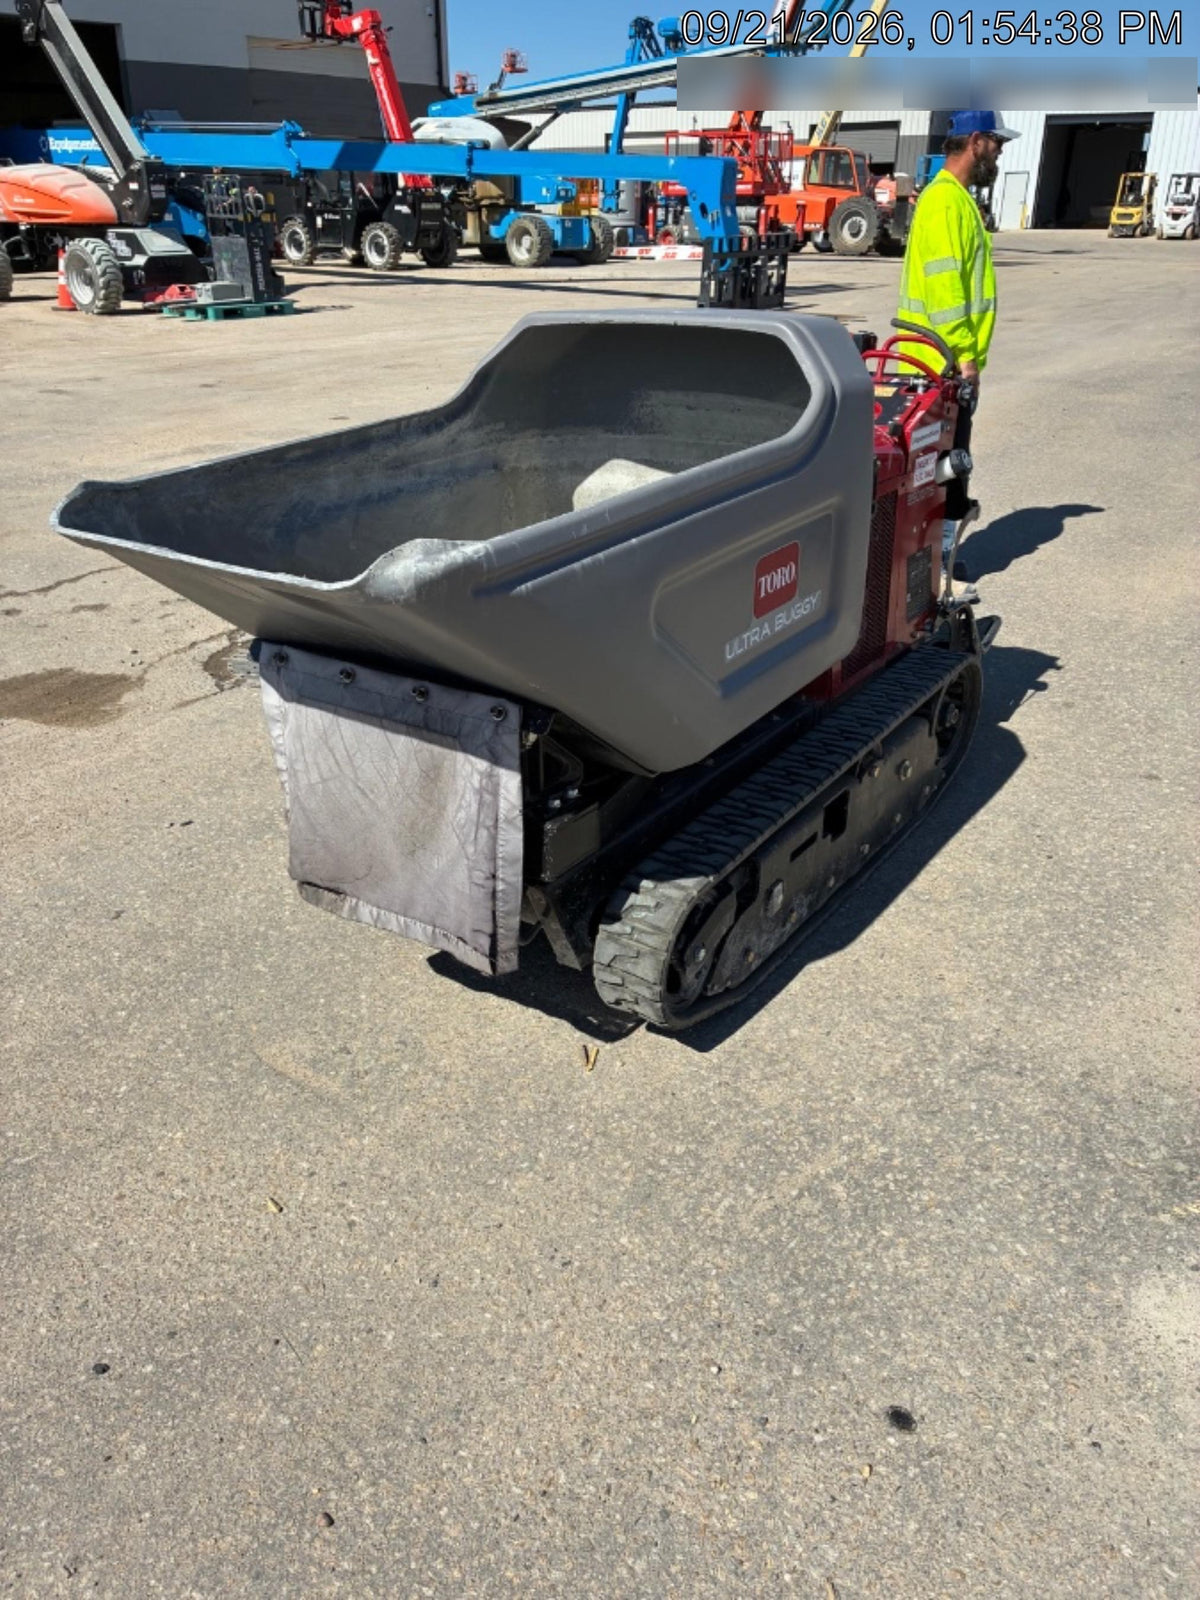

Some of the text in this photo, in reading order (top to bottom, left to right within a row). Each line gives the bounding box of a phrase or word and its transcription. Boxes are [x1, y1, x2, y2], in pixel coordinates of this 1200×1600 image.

[758, 561, 797, 598] TORO
[725, 590, 822, 660] ULTRA BUGGY
